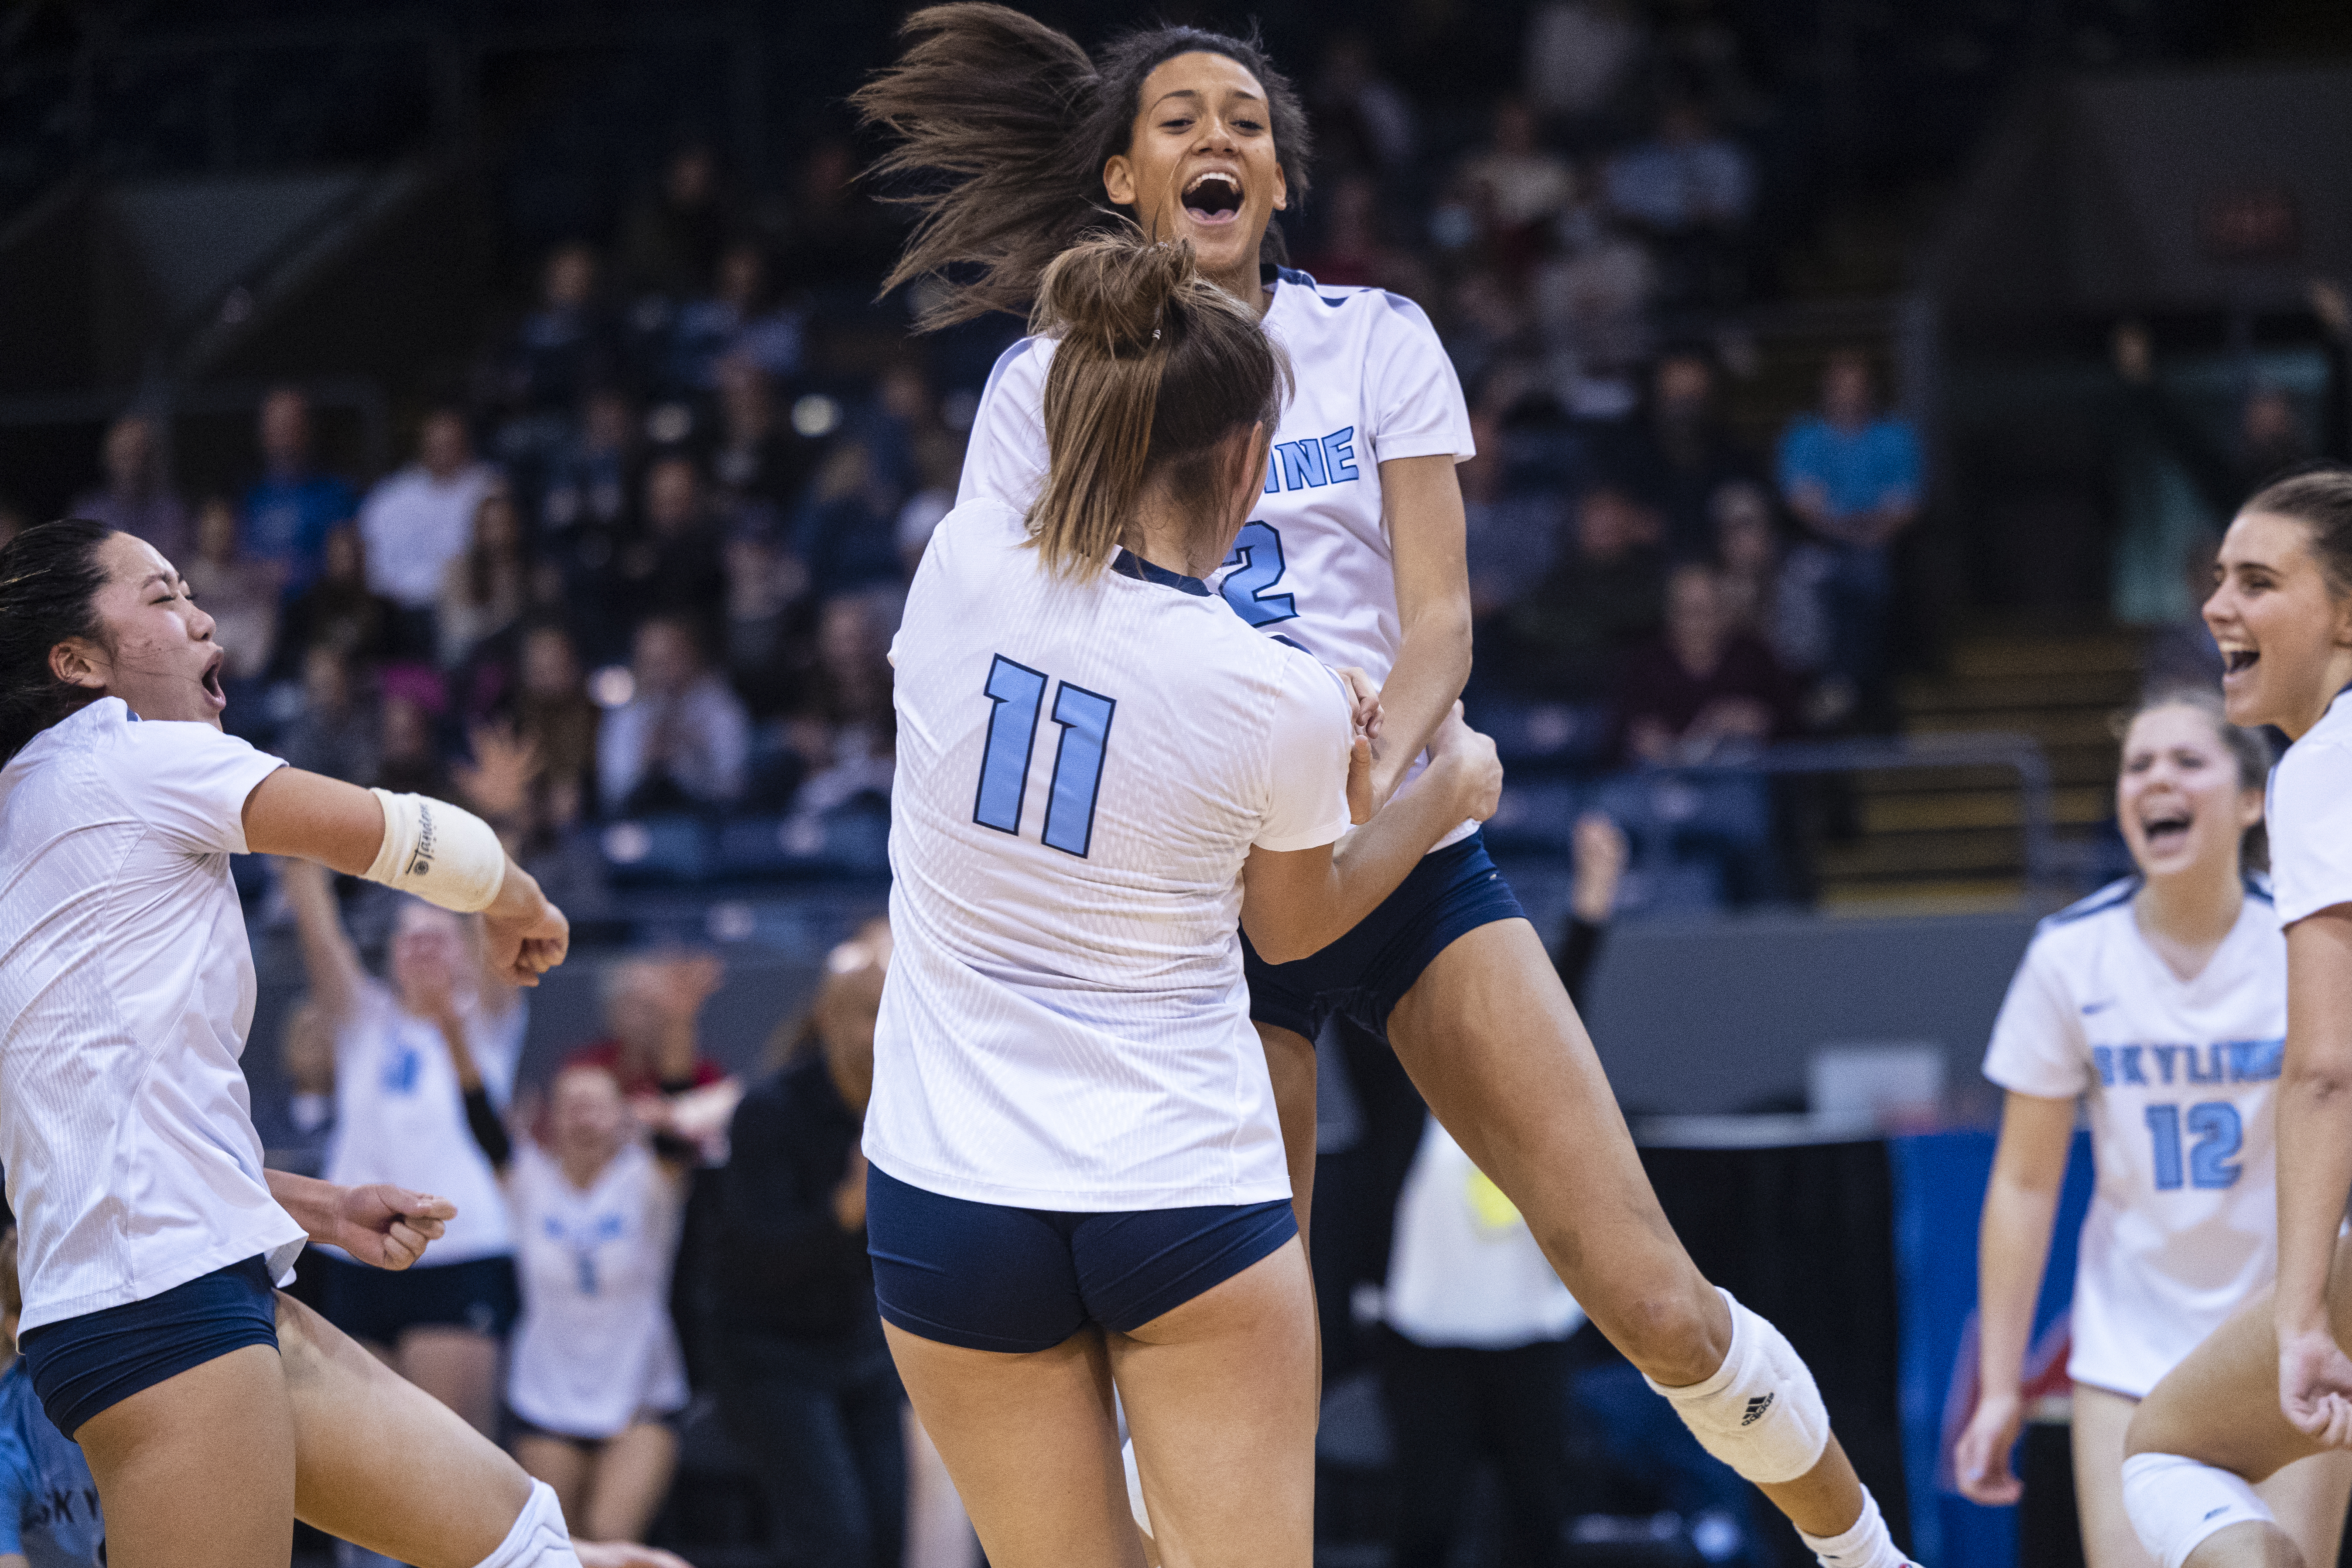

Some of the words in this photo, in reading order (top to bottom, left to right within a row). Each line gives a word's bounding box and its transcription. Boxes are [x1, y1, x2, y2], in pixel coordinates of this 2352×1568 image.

[973, 652, 1117, 859] 11
[2145, 1101, 2243, 1190] 12
[1741, 1391, 1774, 1426] adidas
